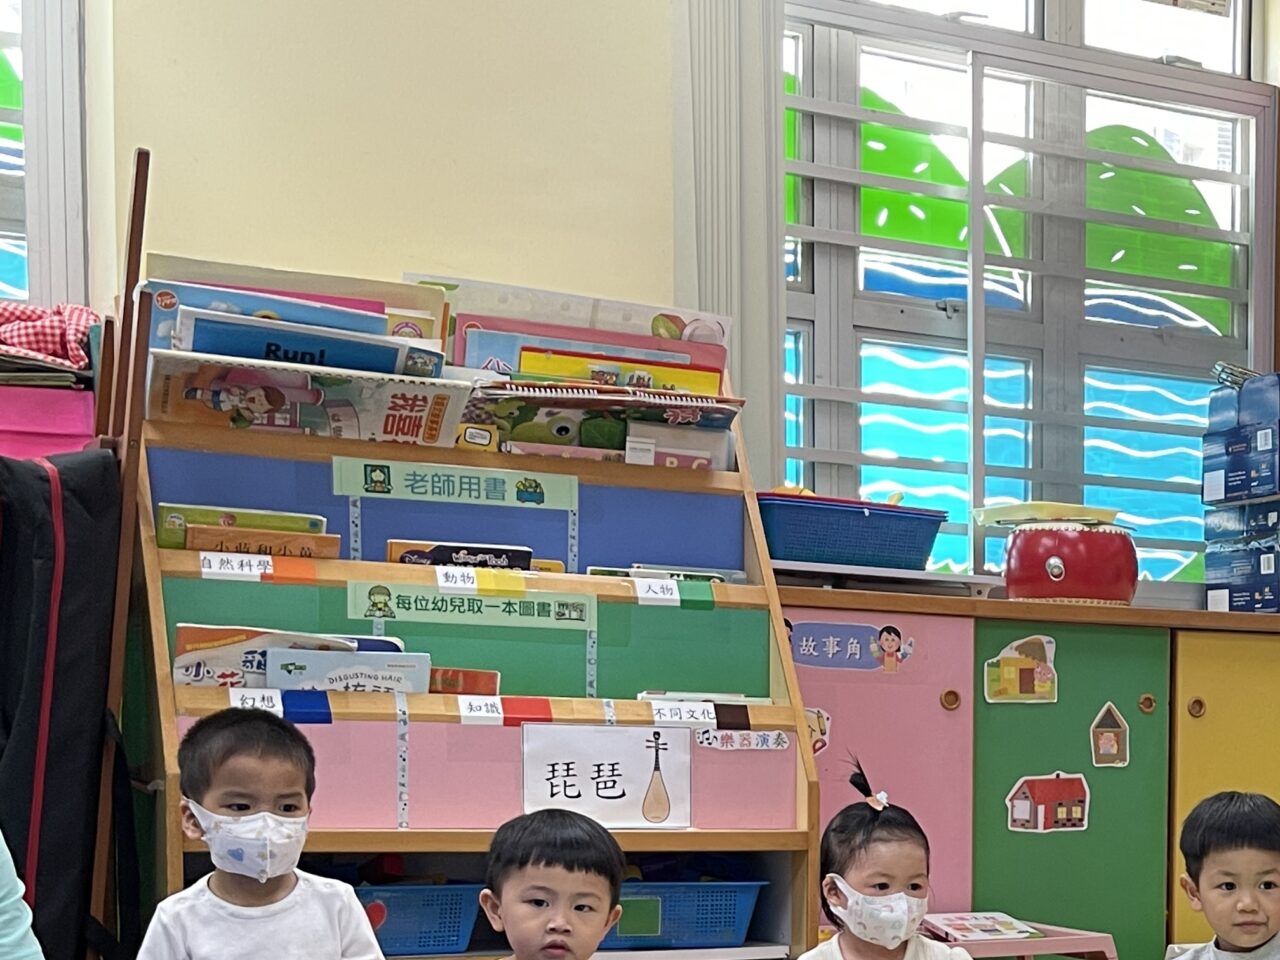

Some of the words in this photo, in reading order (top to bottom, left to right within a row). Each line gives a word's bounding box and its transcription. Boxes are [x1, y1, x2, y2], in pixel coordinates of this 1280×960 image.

[265, 341, 326, 366] Run!
[383, 391, 429, 446] 我喜
[403, 470, 508, 502] 老師用書
[201, 556, 272, 574] 自然科學
[441, 567, 475, 585] 動物
[644, 583, 674, 597] 人物
[395, 593, 551, 618] 每位幼兒取一本圖書
[799, 634, 862, 660] 故事角
[328, 671, 379, 685] DISGUSTING
[380, 675, 403, 684] HAIR
[239, 693, 276, 709] 幻想
[466, 700, 501, 716] 知識
[653, 706, 717, 722] 不同文化
[719, 731, 788, 749] 樂器演奏
[544, 760, 627, 800] 琵琶
